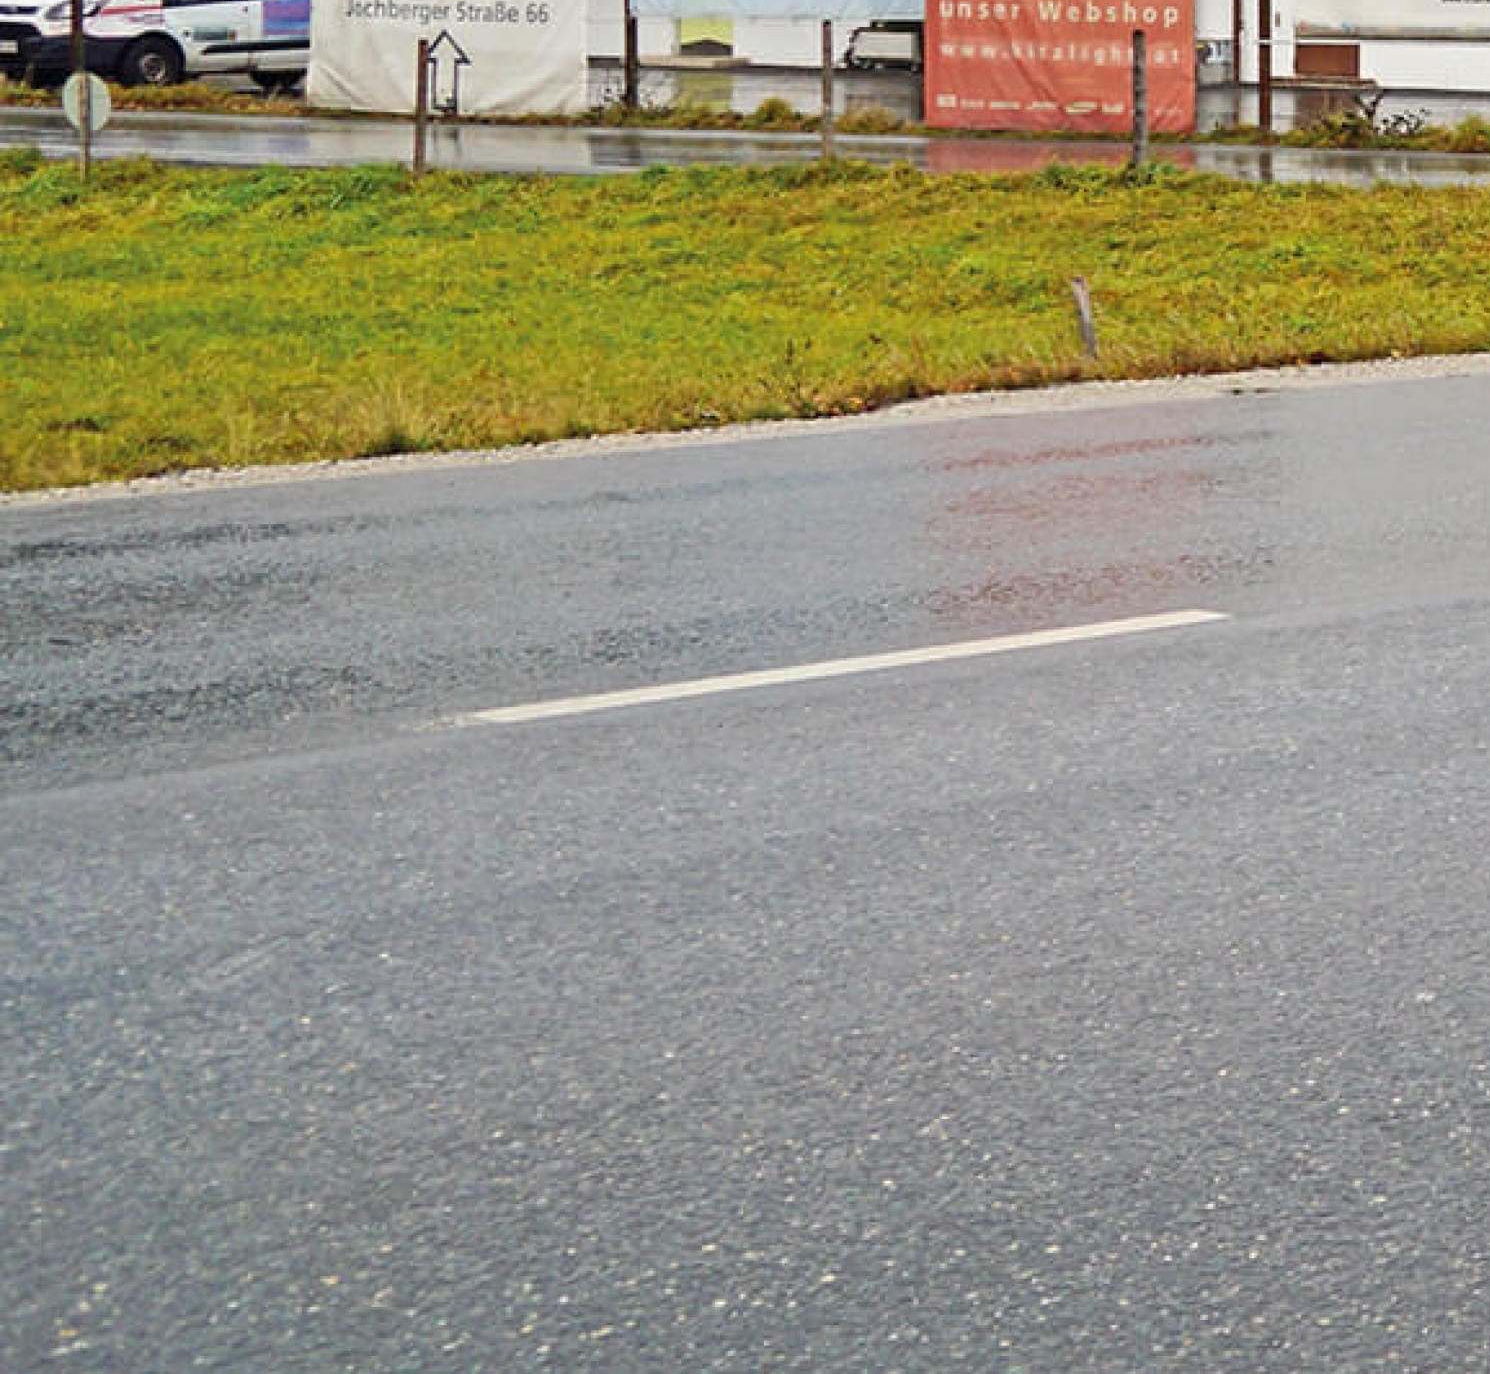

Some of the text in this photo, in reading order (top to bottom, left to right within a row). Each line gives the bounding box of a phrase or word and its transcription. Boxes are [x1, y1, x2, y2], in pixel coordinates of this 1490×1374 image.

[456, 0, 520, 23] Straße
[525, 3, 549, 23] 66
[1037, 0, 1180, 28] Webshop
